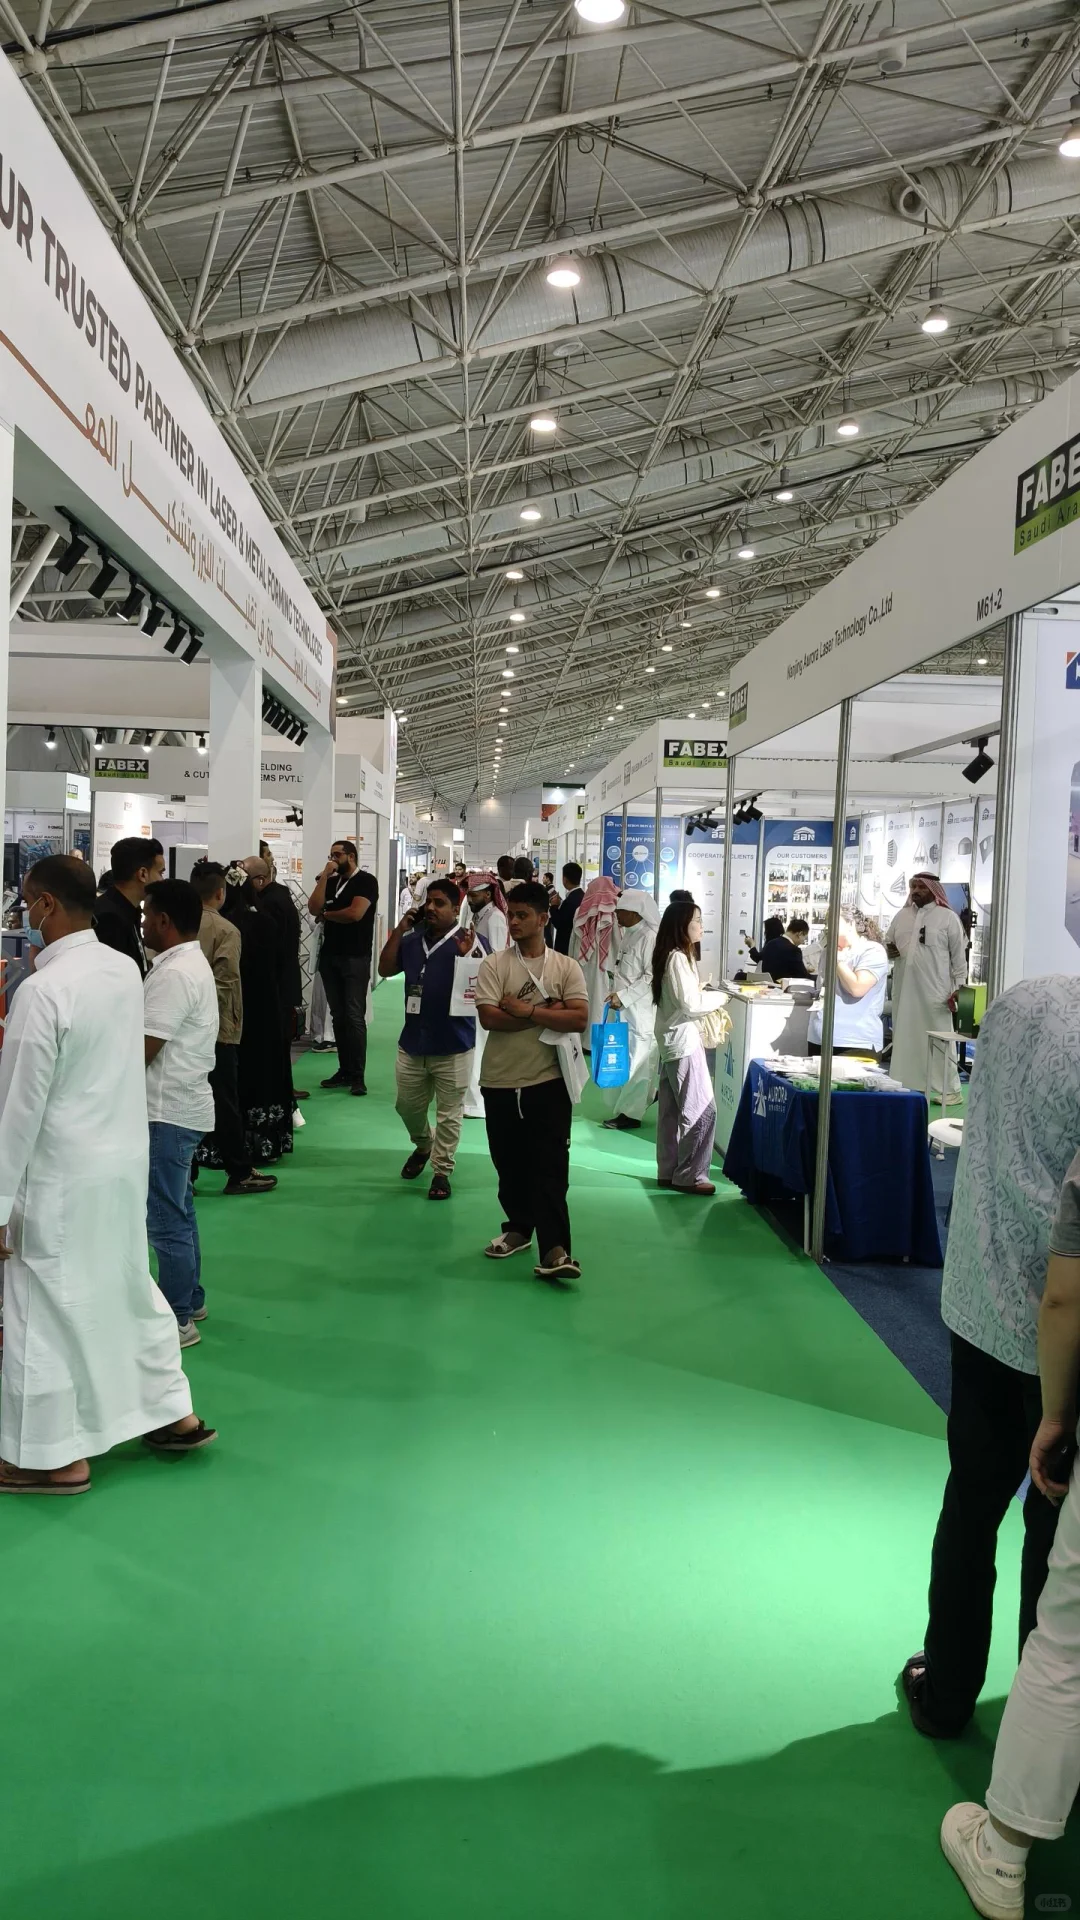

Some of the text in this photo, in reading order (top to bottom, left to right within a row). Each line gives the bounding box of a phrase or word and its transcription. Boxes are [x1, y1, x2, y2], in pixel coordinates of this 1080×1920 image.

[41, 215, 131, 393] TRUSTED
[135, 361, 195, 487] PARTNER
[197, 455, 208, 507] IN
[210, 475, 238, 547] LASER
[239, 521, 244, 556] &
[245, 530, 267, 590] METAL
[268, 564, 293, 626] FORMING
[293, 602, 323, 667] TECHNOLOGIES
[1020, 514, 1051, 546] Saudi
[976, 587, 1003, 621] M61-2
[803, 652, 819, 668] Aurora
[819, 641, 834, 658] Laser
[834, 614, 868, 647] Technology
[98, 759, 146, 771] FABEX
[183, 770, 191, 778] &
[668, 759, 696, 767] Saudi
